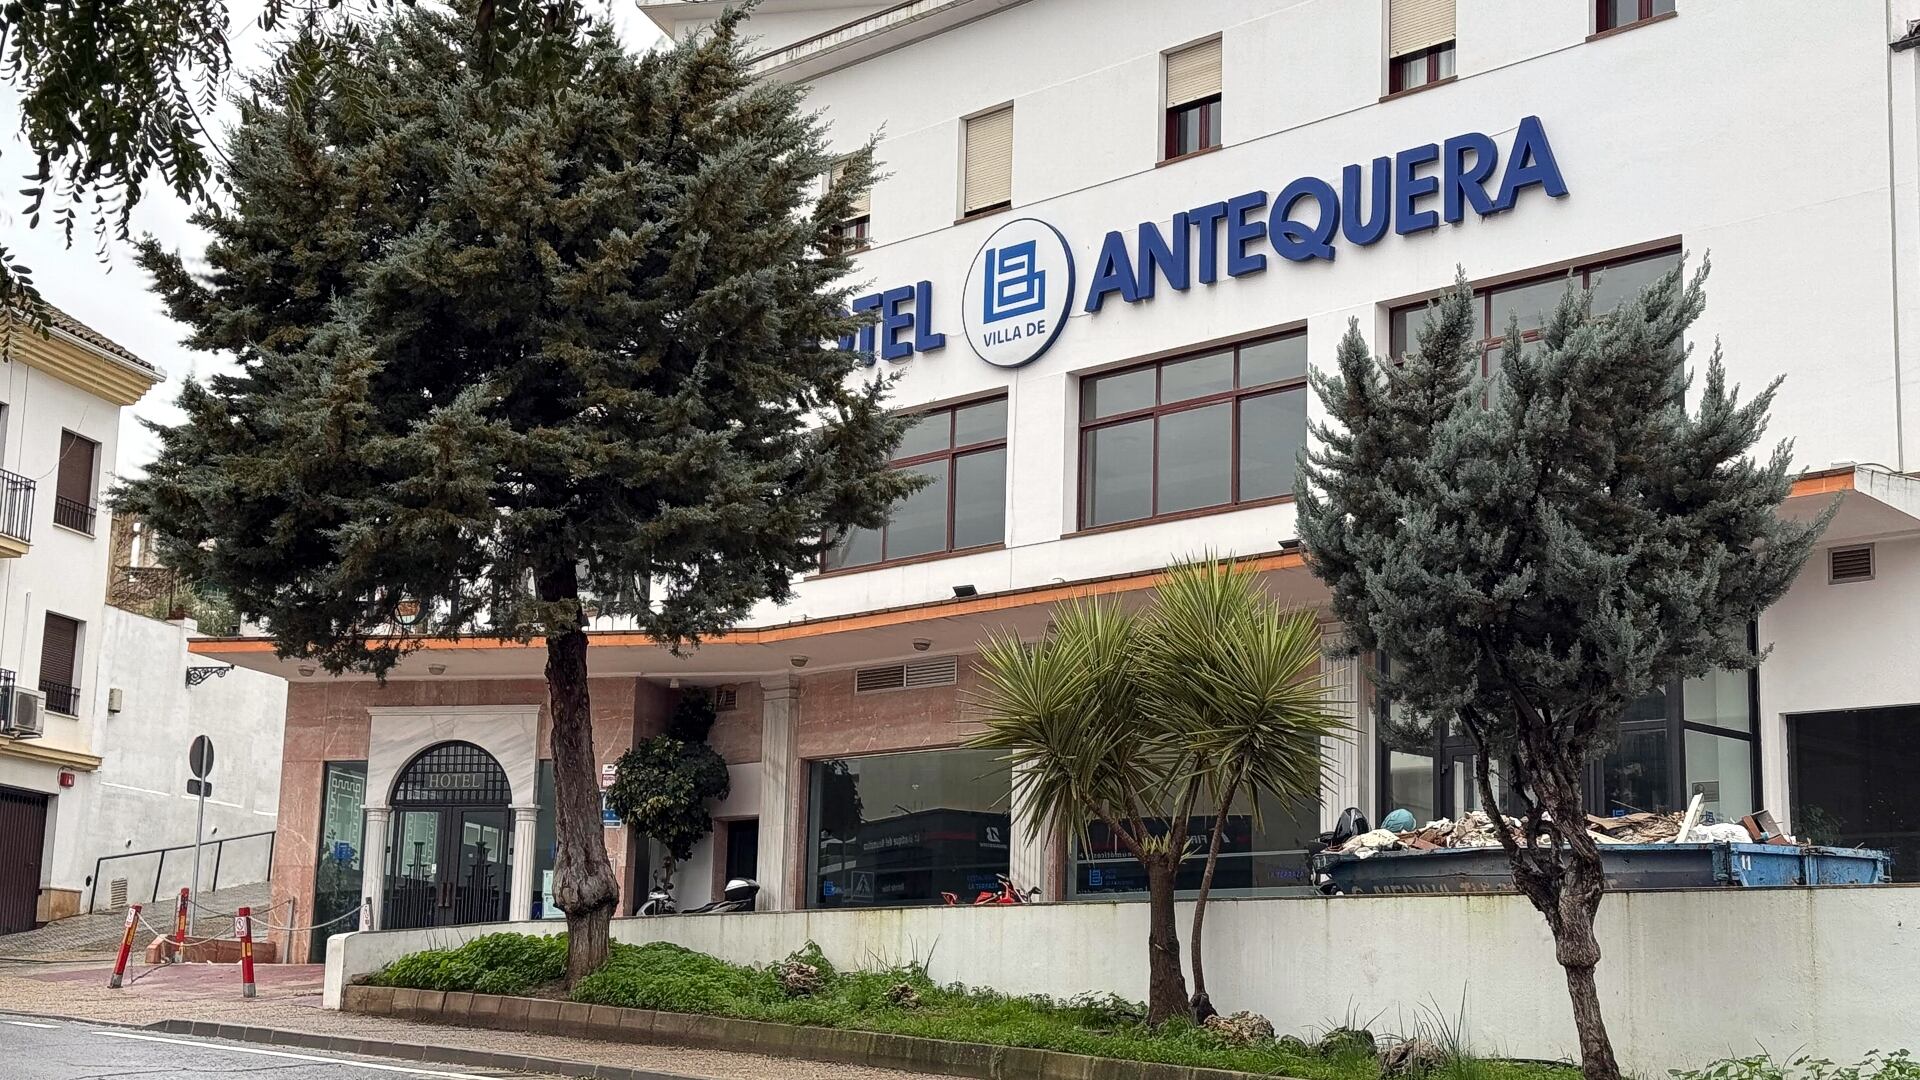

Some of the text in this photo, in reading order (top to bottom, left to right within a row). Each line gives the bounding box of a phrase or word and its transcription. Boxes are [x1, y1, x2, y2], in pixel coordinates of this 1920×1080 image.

[824, 115, 1568, 366] TEL ANTEQUERA
[984, 320, 1045, 347] VILLA DE
[429, 773, 480, 788] HOTEL
